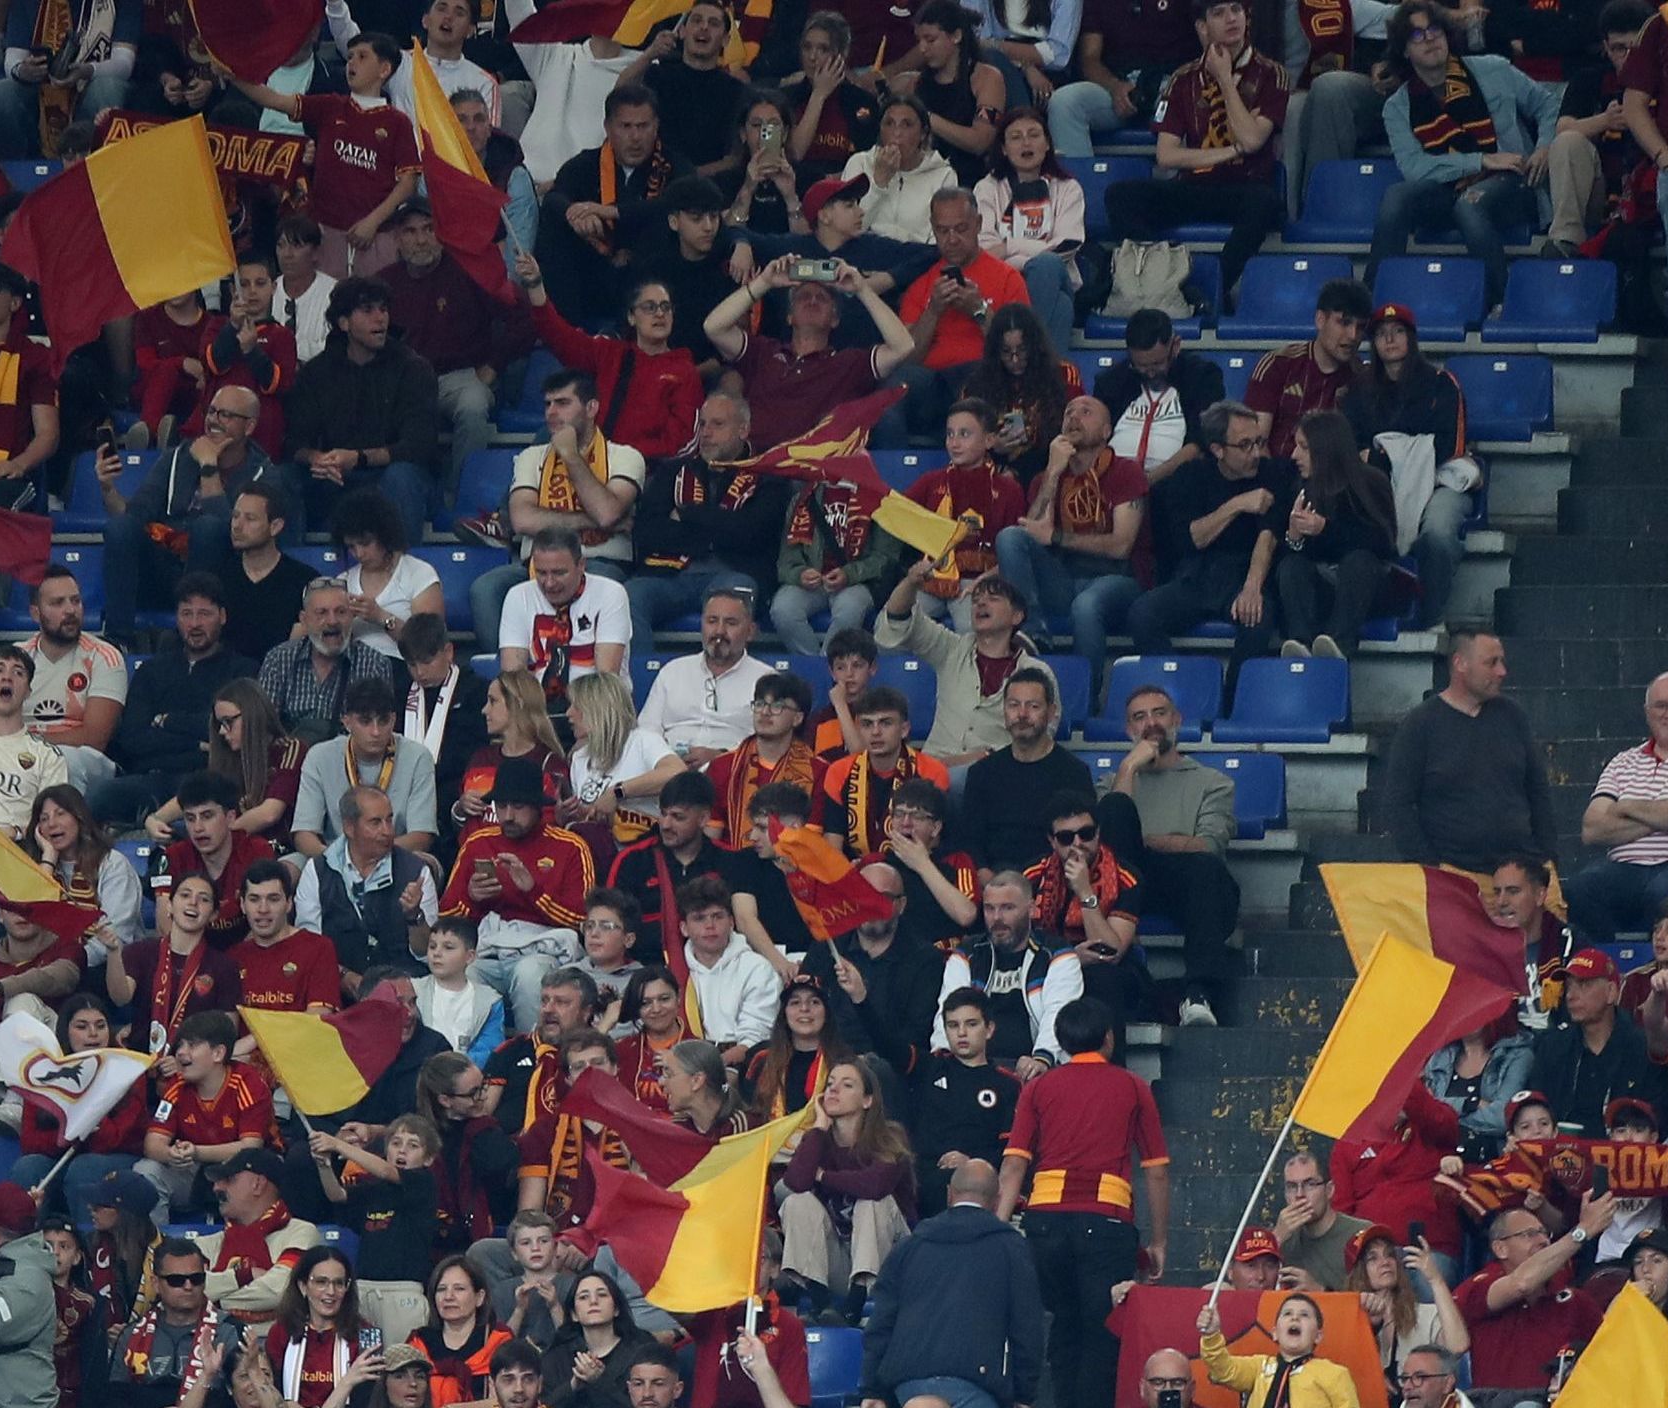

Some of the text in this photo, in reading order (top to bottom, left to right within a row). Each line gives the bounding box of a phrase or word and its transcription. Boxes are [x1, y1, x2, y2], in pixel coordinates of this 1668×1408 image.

[206, 130, 298, 179] OMA
[334, 138, 378, 163] QATAR
[244, 991, 294, 1005] italbits
[301, 1371, 334, 1383] italbit
